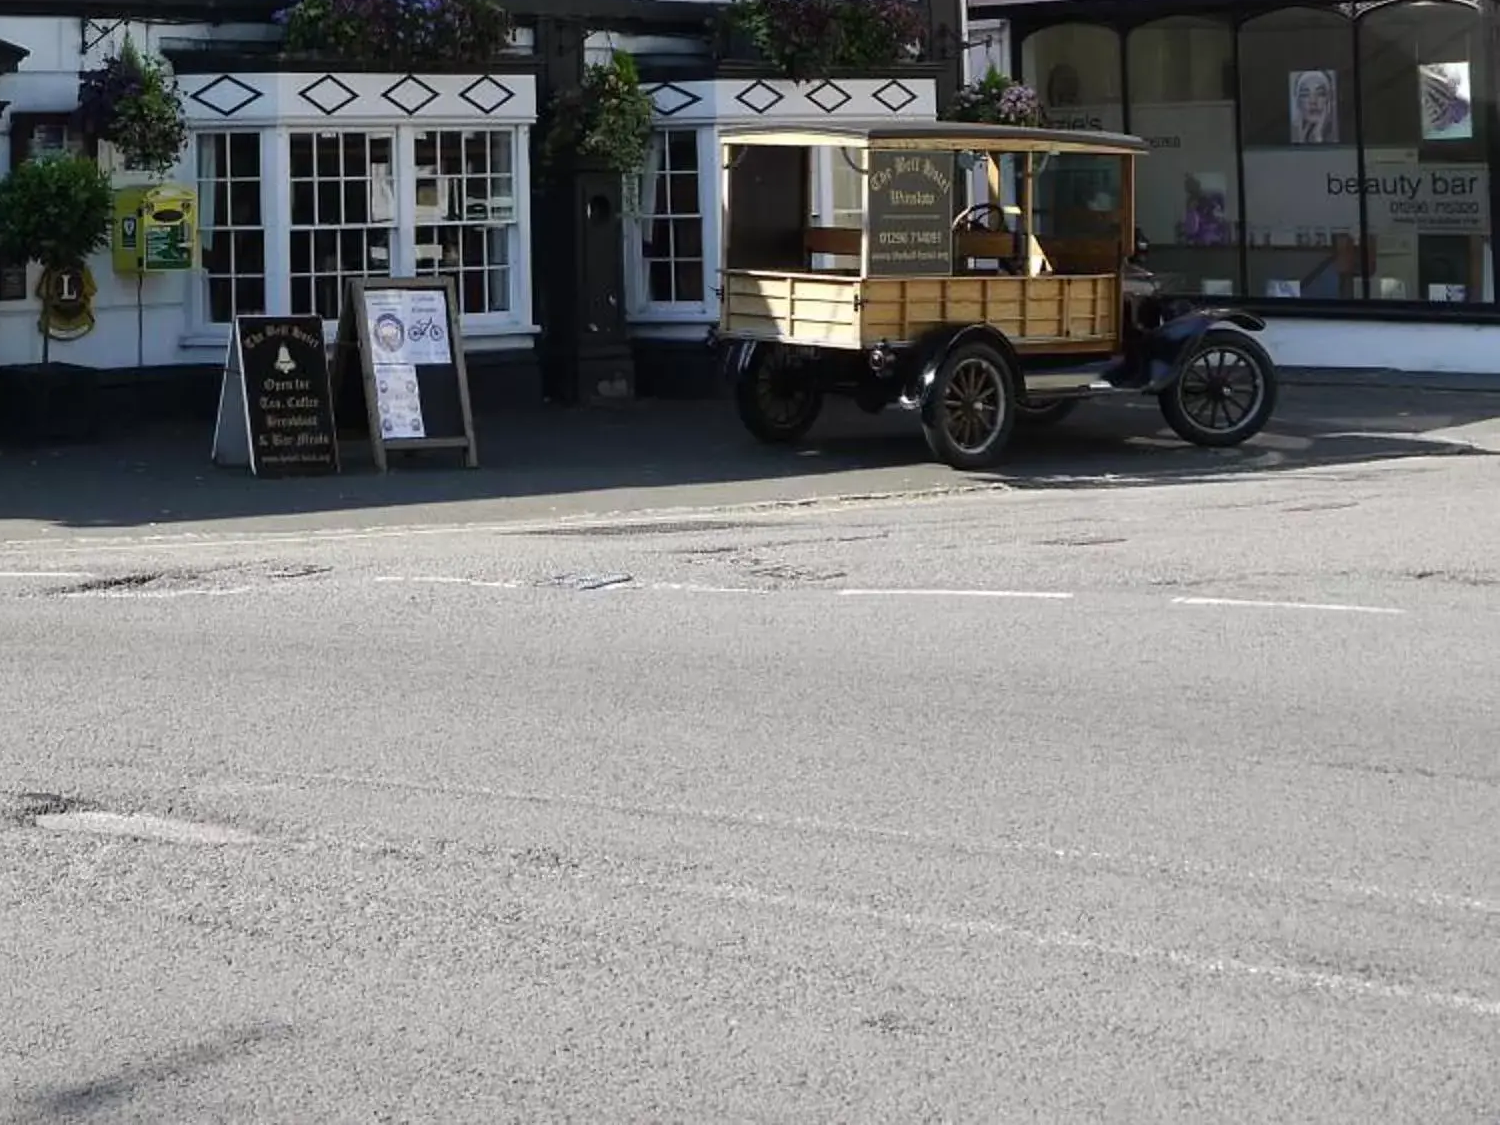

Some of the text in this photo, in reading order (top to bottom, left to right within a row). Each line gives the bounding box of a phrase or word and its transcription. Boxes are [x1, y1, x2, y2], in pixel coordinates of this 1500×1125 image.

[1326, 172, 1478, 200] beauty bar
[60, 275, 77, 300] L
